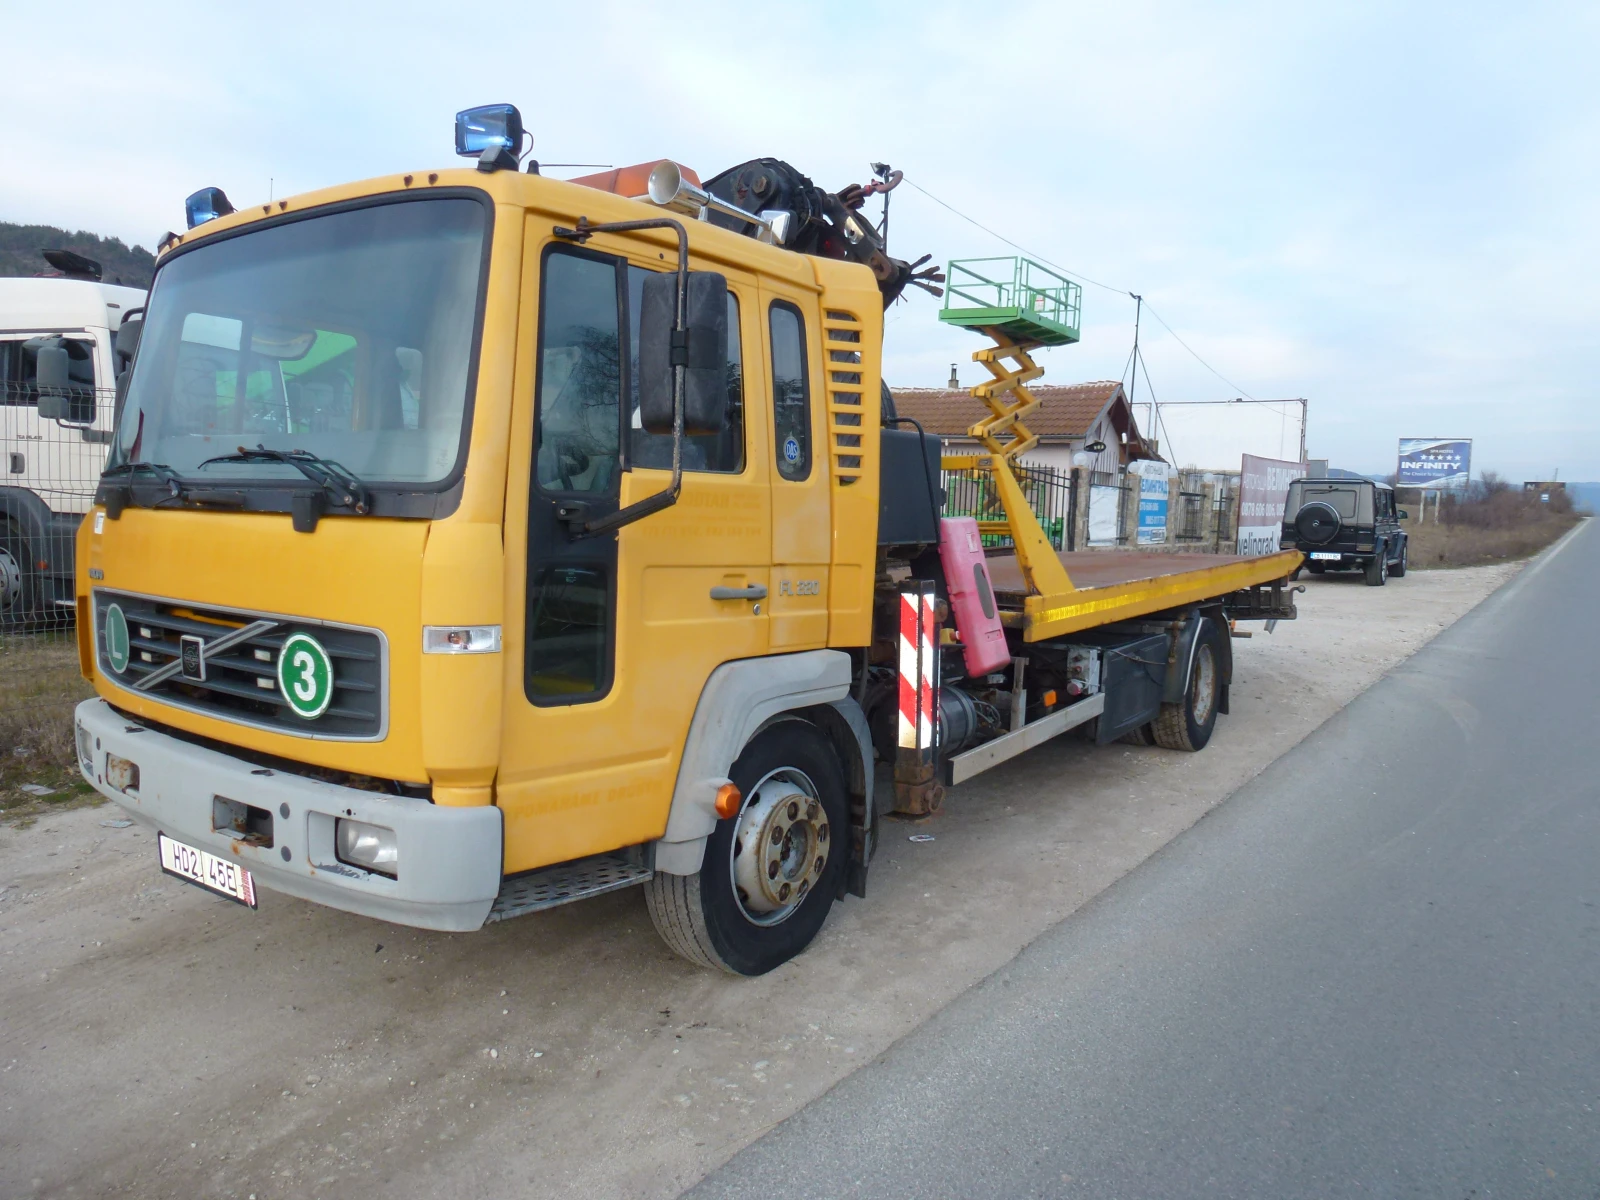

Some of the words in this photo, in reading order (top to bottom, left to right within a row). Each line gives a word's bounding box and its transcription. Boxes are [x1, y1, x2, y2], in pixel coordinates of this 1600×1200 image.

[786, 442, 798, 458] DAS
[1401, 461, 1461, 470] INFINITY
[780, 580, 794, 596] FL
[796, 580, 819, 596] 220
[110, 617, 123, 660] L
[293, 650, 317, 702] 3
